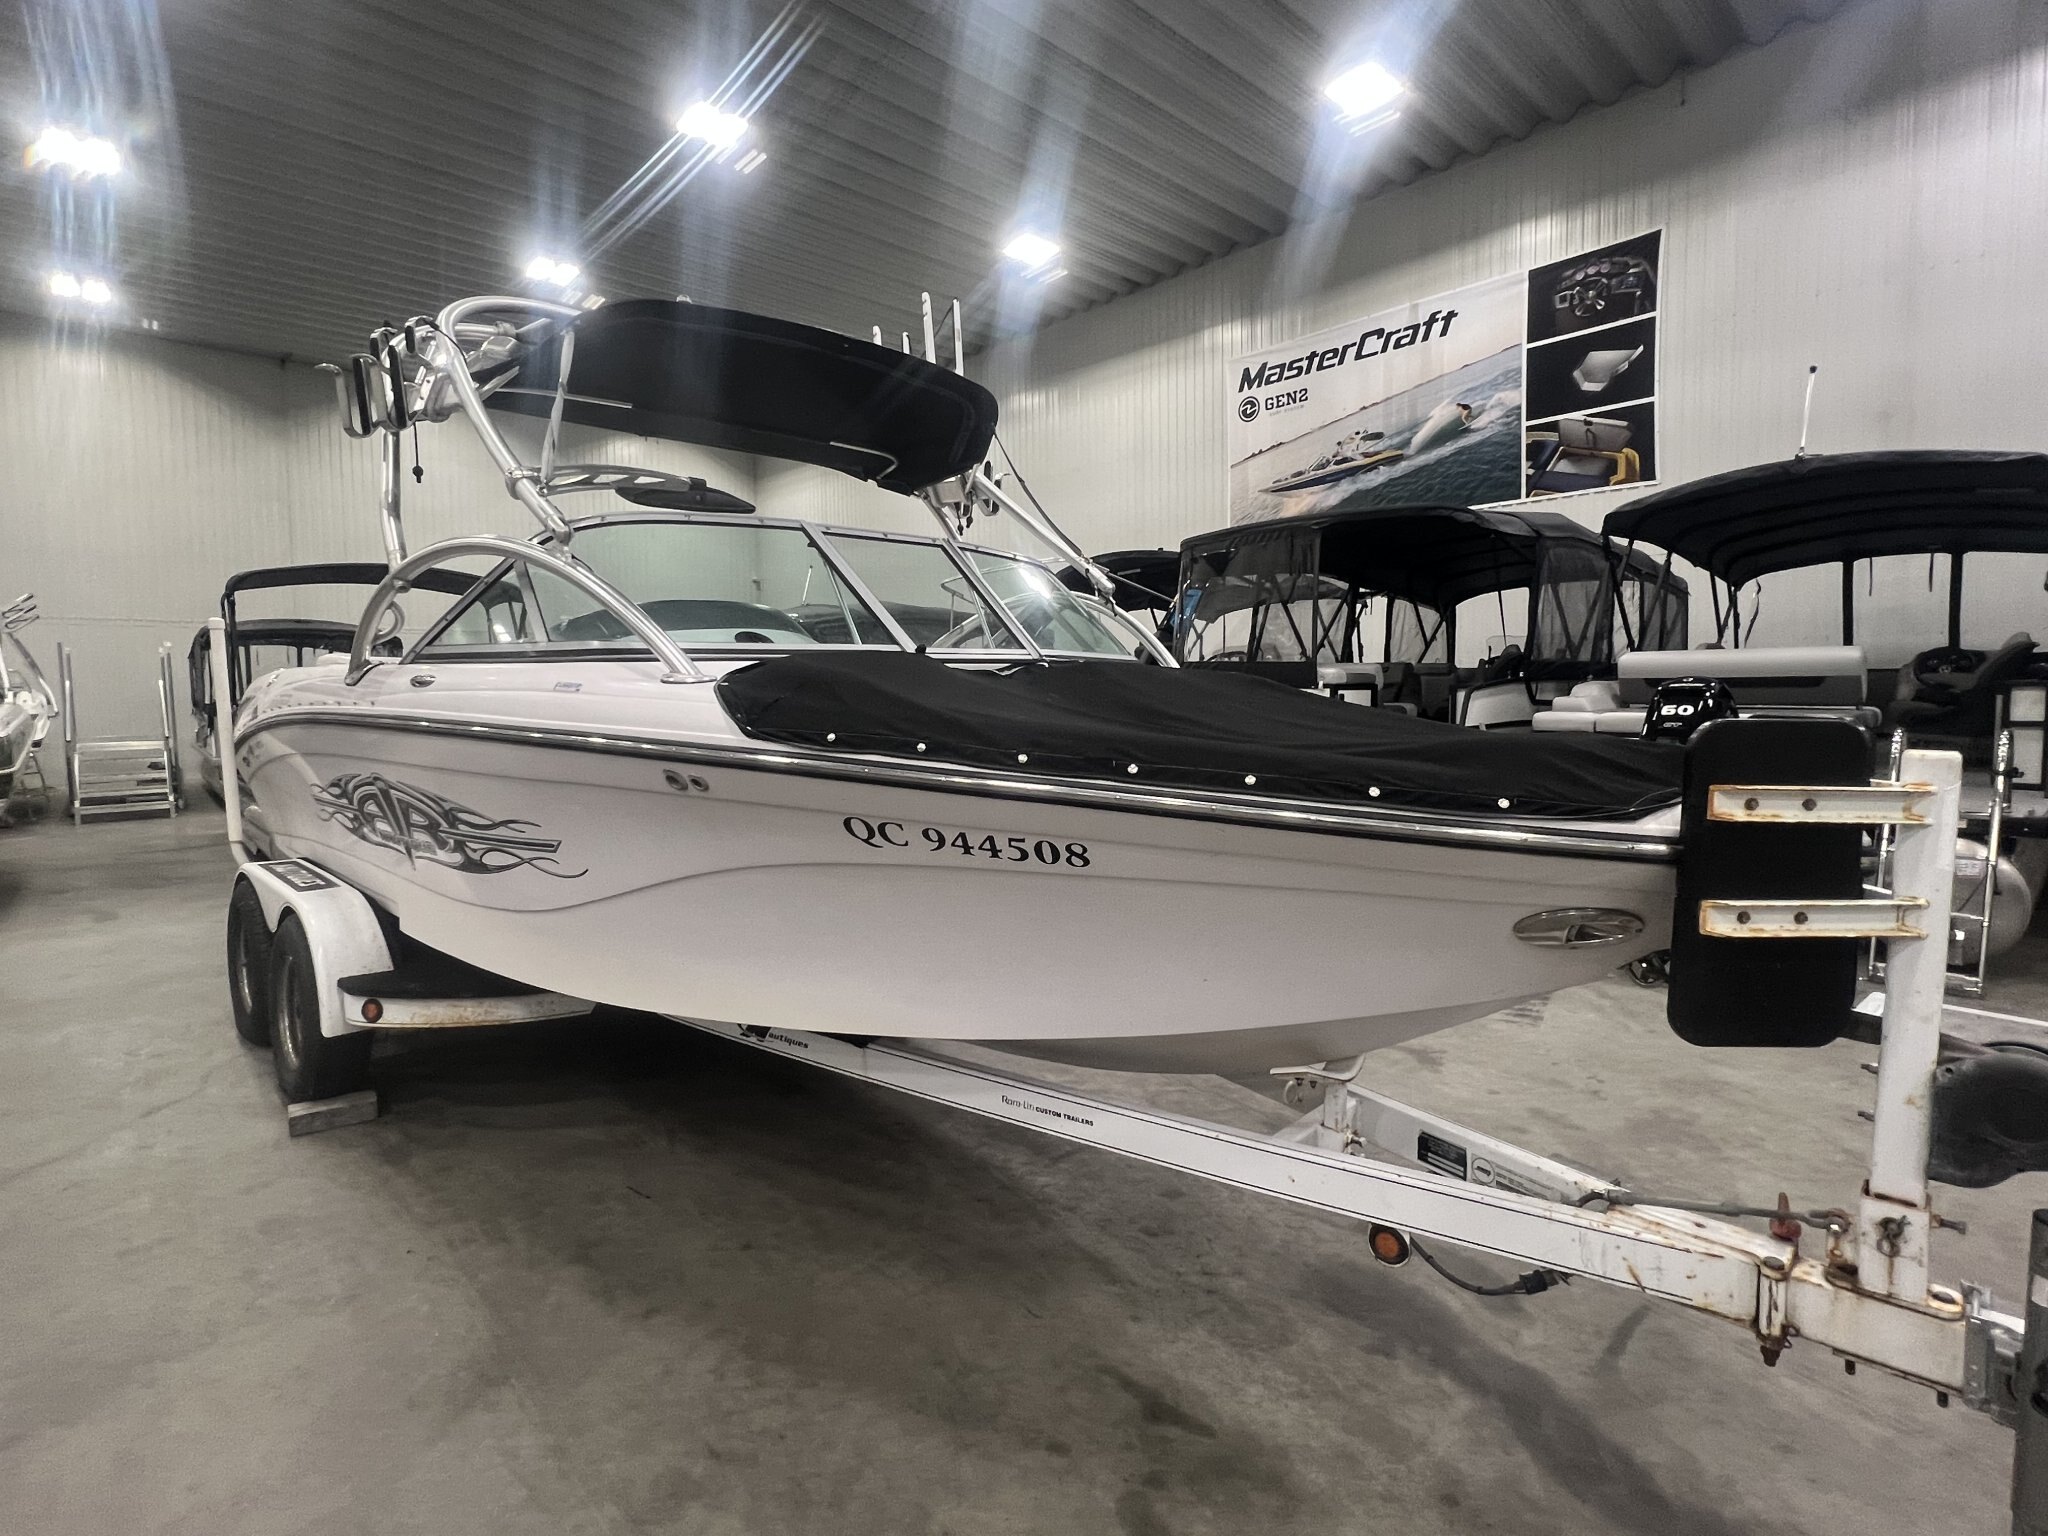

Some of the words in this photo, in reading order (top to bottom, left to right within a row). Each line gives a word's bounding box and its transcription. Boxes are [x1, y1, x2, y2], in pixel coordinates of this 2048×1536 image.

[1238, 309, 1459, 393] MasterCraft
[1265, 388, 1308, 411] GEN2
[1660, 704, 1695, 716] 60
[842, 816, 909, 849] QC
[921, 827, 1091, 868] 944508
[1035, 1106, 1062, 1118] CUSTOM
[1063, 1113, 1094, 1127] TRAILERS
